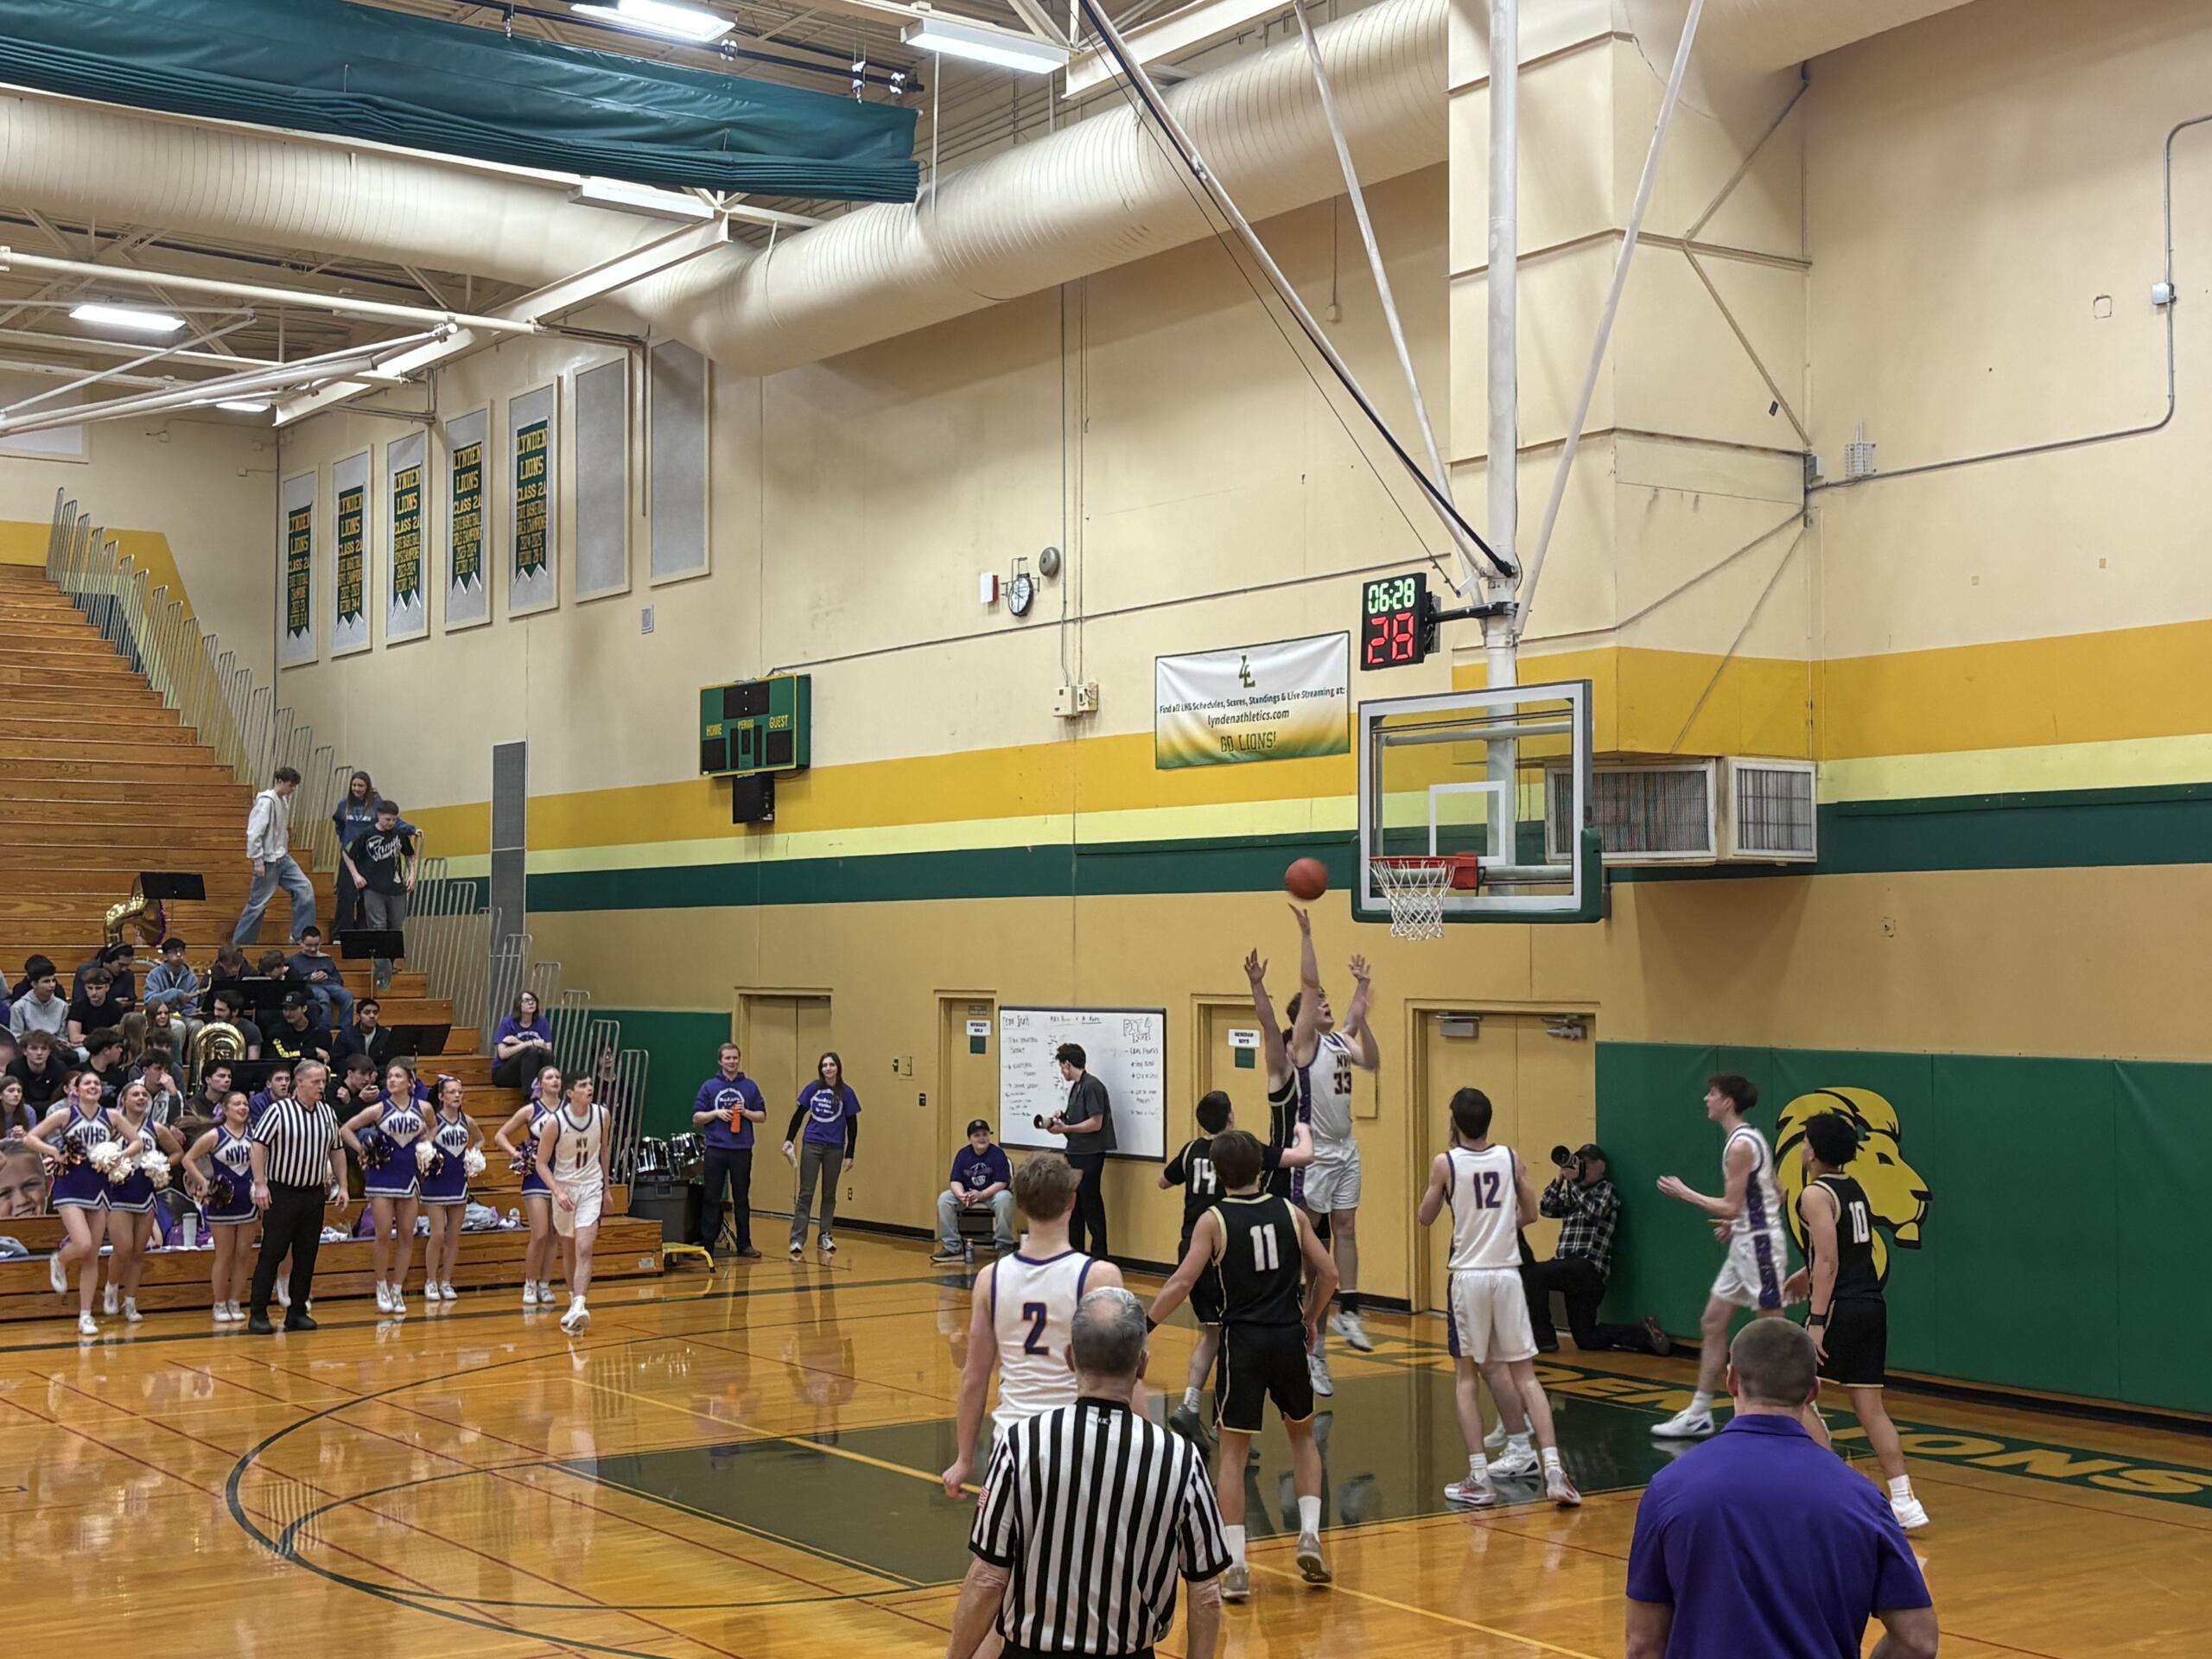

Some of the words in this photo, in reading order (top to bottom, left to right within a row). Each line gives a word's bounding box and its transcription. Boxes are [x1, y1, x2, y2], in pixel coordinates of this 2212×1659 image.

[517, 428, 548, 456] LYNDEN
[453, 444, 482, 471] LYNDEN
[520, 455, 544, 480] LIONS
[394, 469, 421, 493] LYNDEN
[456, 470, 479, 494] LIONS
[517, 482, 537, 503] CLASS
[397, 492, 417, 516] LIONS
[453, 497, 472, 516] CLASS
[394, 517, 411, 536] CLASS
[1368, 577, 1416, 614] 06:28
[1368, 612, 1414, 664] 28
[1160, 704, 1172, 714] Find
[1181, 702, 1192, 712] LHS
[1249, 694, 1280, 705] Standings
[1287, 690, 1300, 701] Live
[1301, 687, 1335, 698] Streaming
[706, 723, 722, 736] HOME
[737, 719, 754, 730] PERIOD
[769, 715, 789, 729] GUEST
[1207, 709, 1290, 728] lyndenathletics.com
[1220, 734, 1234, 753] GO
[1239, 731, 1277, 753] LIONS!
[1333, 1071, 1352, 1095] 33
[389, 1117, 420, 1134] NVHS
[442, 1129, 467, 1147] NVHS
[575, 1137, 588, 1148] NV
[575, 1151, 588, 1169] 11
[1192, 1157, 1217, 1195] 14
[1473, 1172, 1502, 1210] 12
[1849, 1201, 1870, 1244] 10
[1249, 1223, 1280, 1272] 11
[1022, 1301, 1050, 1356] 2
